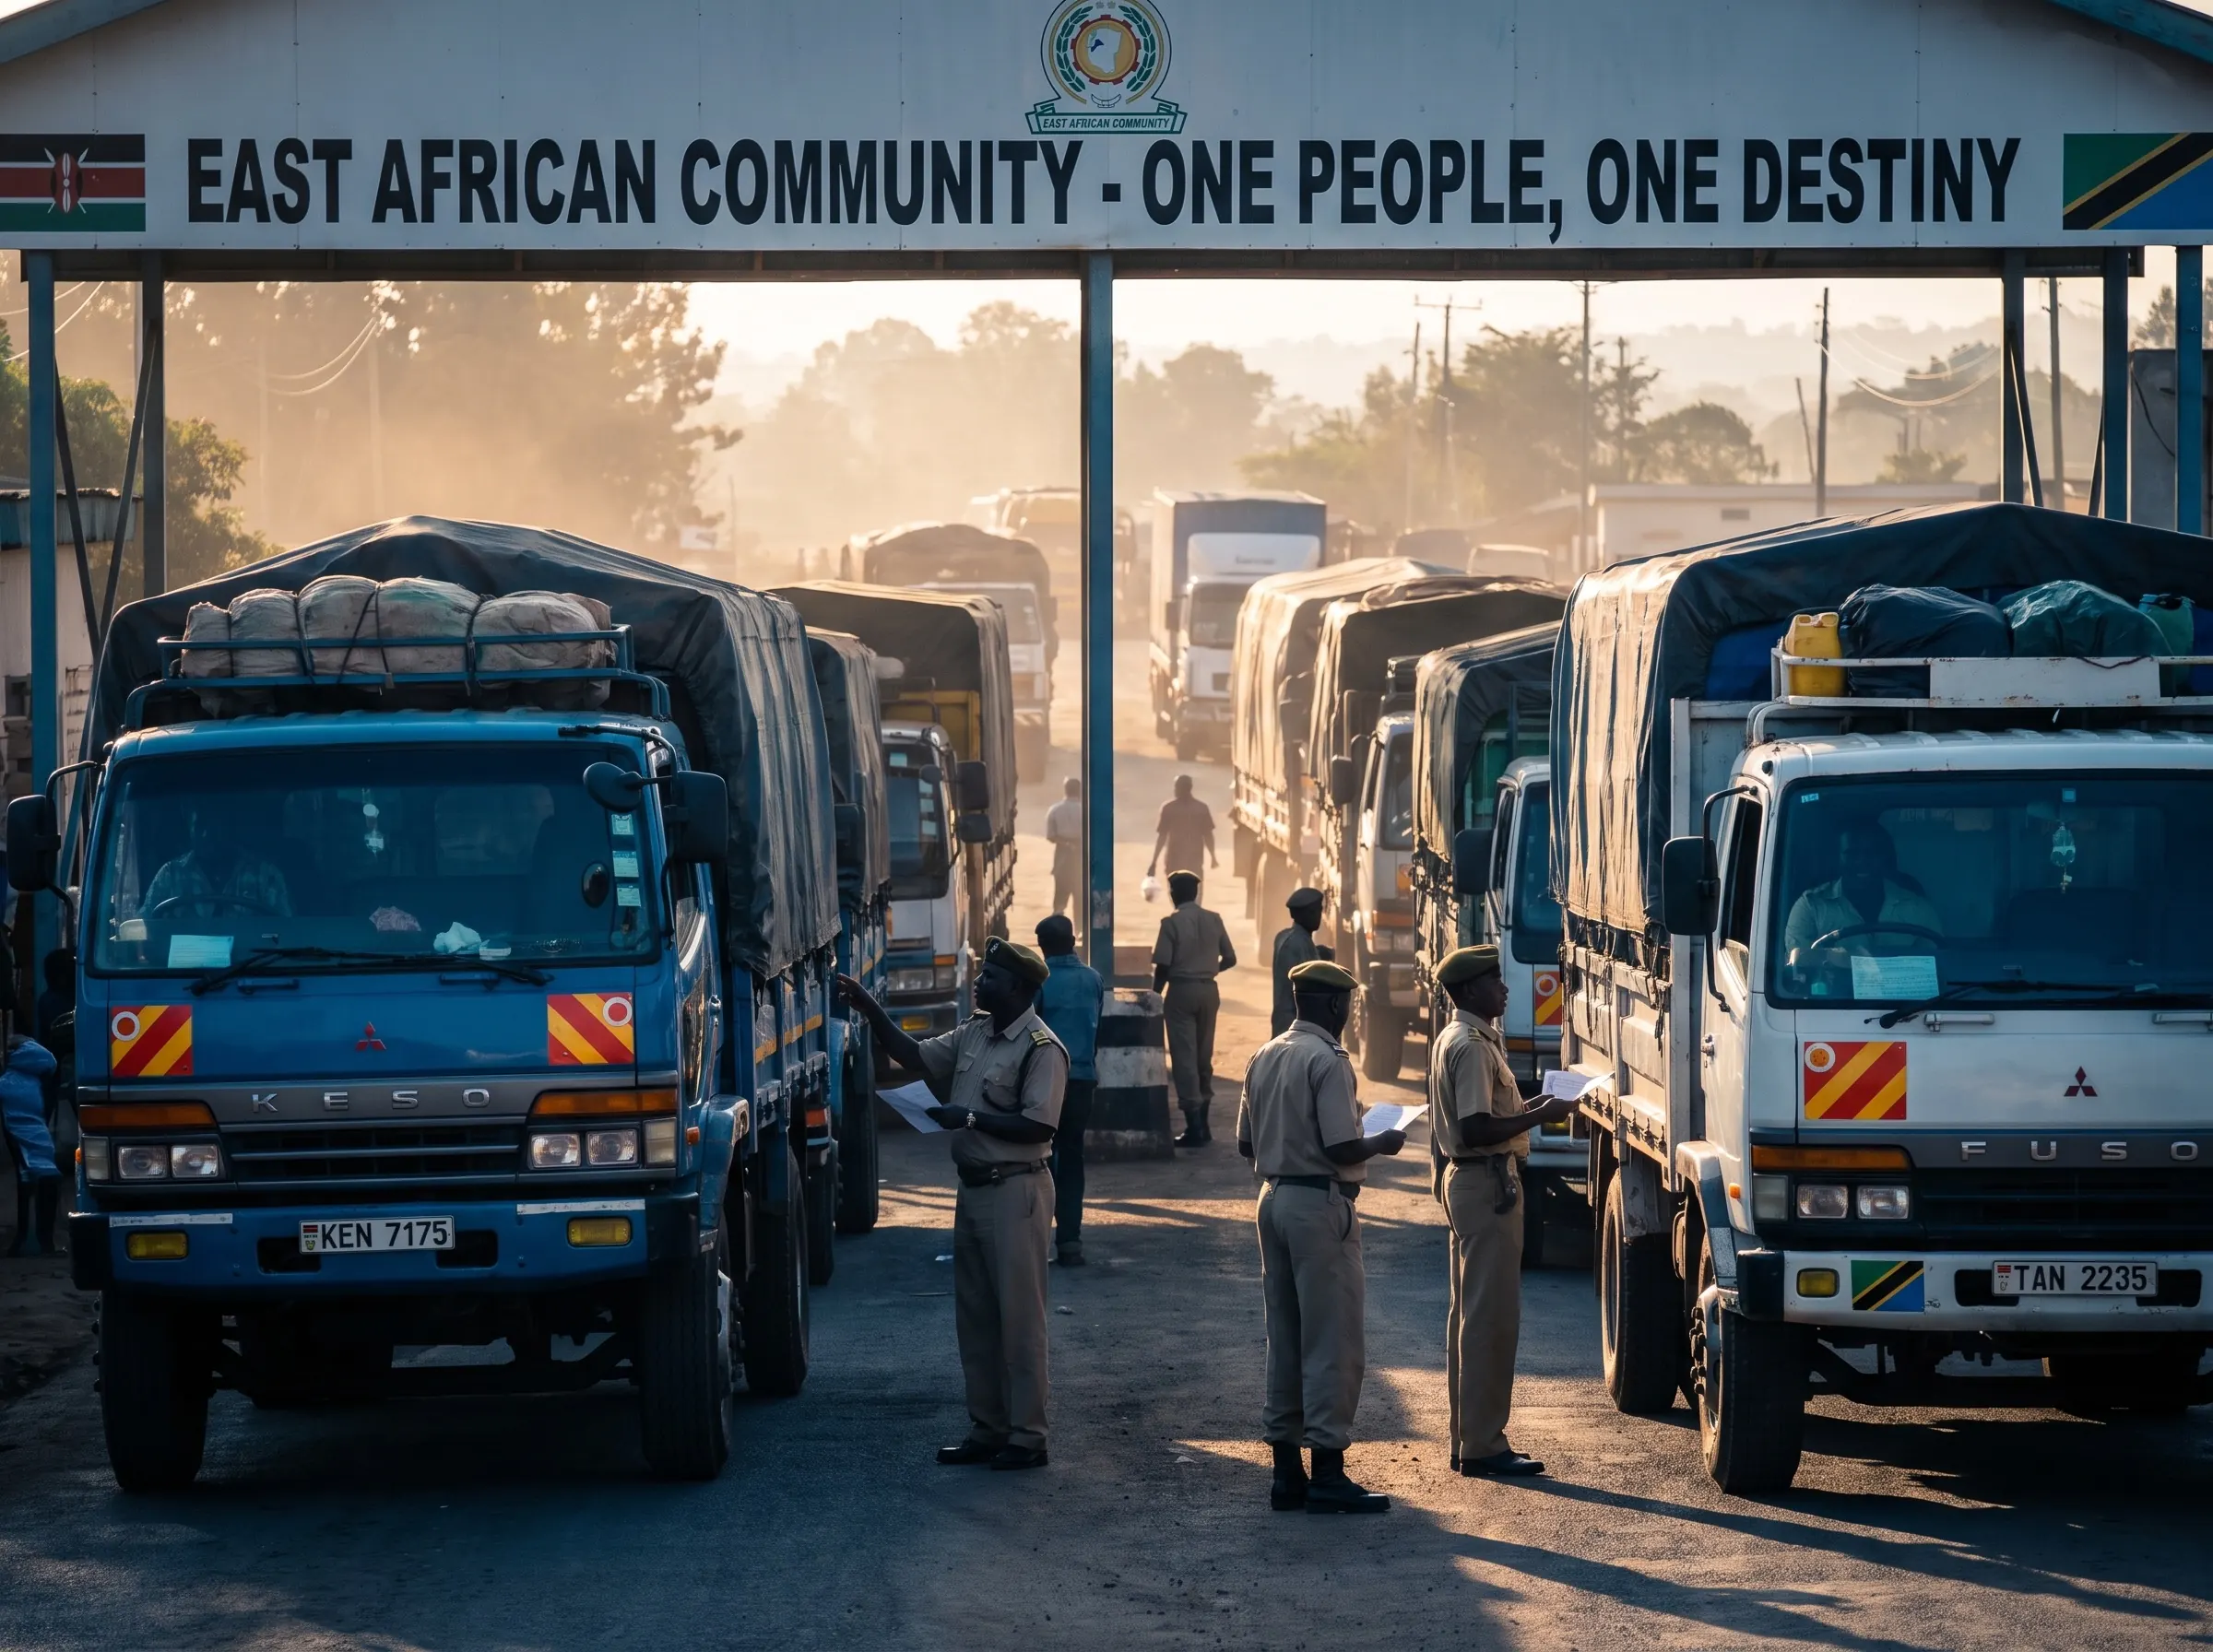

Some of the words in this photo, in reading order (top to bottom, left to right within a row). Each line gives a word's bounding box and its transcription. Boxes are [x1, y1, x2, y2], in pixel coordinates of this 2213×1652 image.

[1043, 118, 1068, 129] EAST
[1069, 118, 1110, 129] AFRICAN
[1112, 118, 1169, 129] COMMUNITY
[188, 138, 352, 224] EAST
[372, 138, 655, 224] AFRICAN
[681, 139, 1083, 225] COMMUNITY
[1102, 183, 1121, 203] -
[1143, 139, 1273, 226] ONE
[1299, 139, 1563, 245] PEOPLE,
[1587, 138, 1718, 224] ONE
[1745, 138, 2021, 223] DESTINY
[252, 1088, 491, 1114] KESO
[1960, 1140, 2199, 1162] FUSO
[321, 1222, 373, 1249] KEN
[385, 1221, 448, 1247] 7175
[2014, 1265, 2065, 1291] TAN
[2080, 1265, 2148, 1292] 2235
